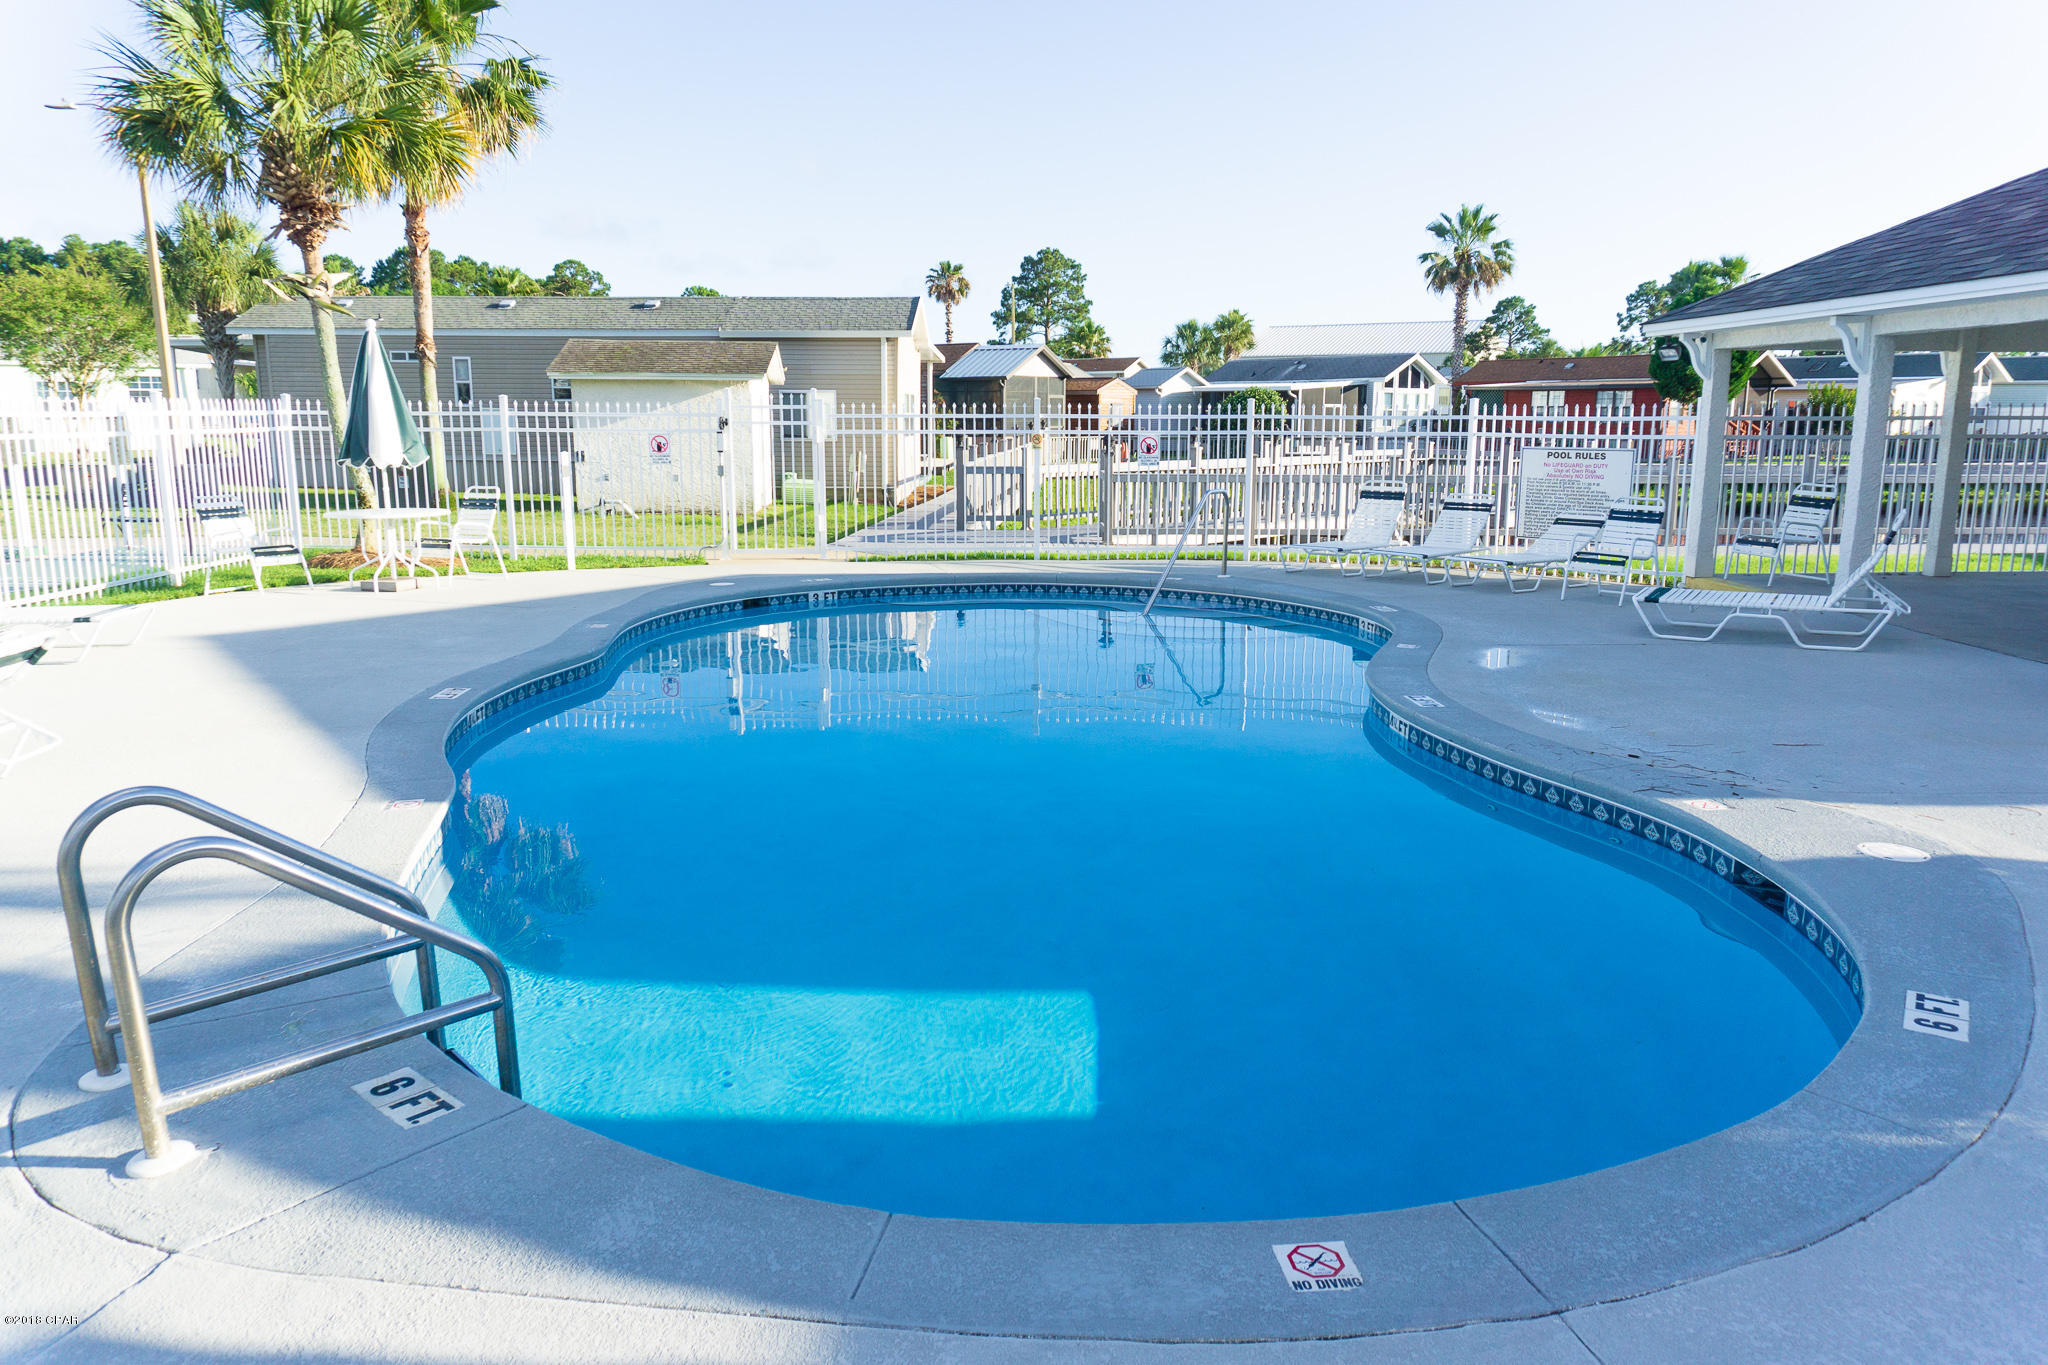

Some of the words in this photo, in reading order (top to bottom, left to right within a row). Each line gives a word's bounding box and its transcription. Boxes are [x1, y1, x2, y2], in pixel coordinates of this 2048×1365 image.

[1547, 451, 1572, 459] POOL
[1575, 452, 1606, 460] RULES
[1399, 720, 1408, 736] FT
[1914, 1018, 1959, 1032] 6
[370, 1077, 416, 1096] 6
[1292, 1280, 1312, 1290] NO
[1315, 1278, 1362, 1289] DIVING
